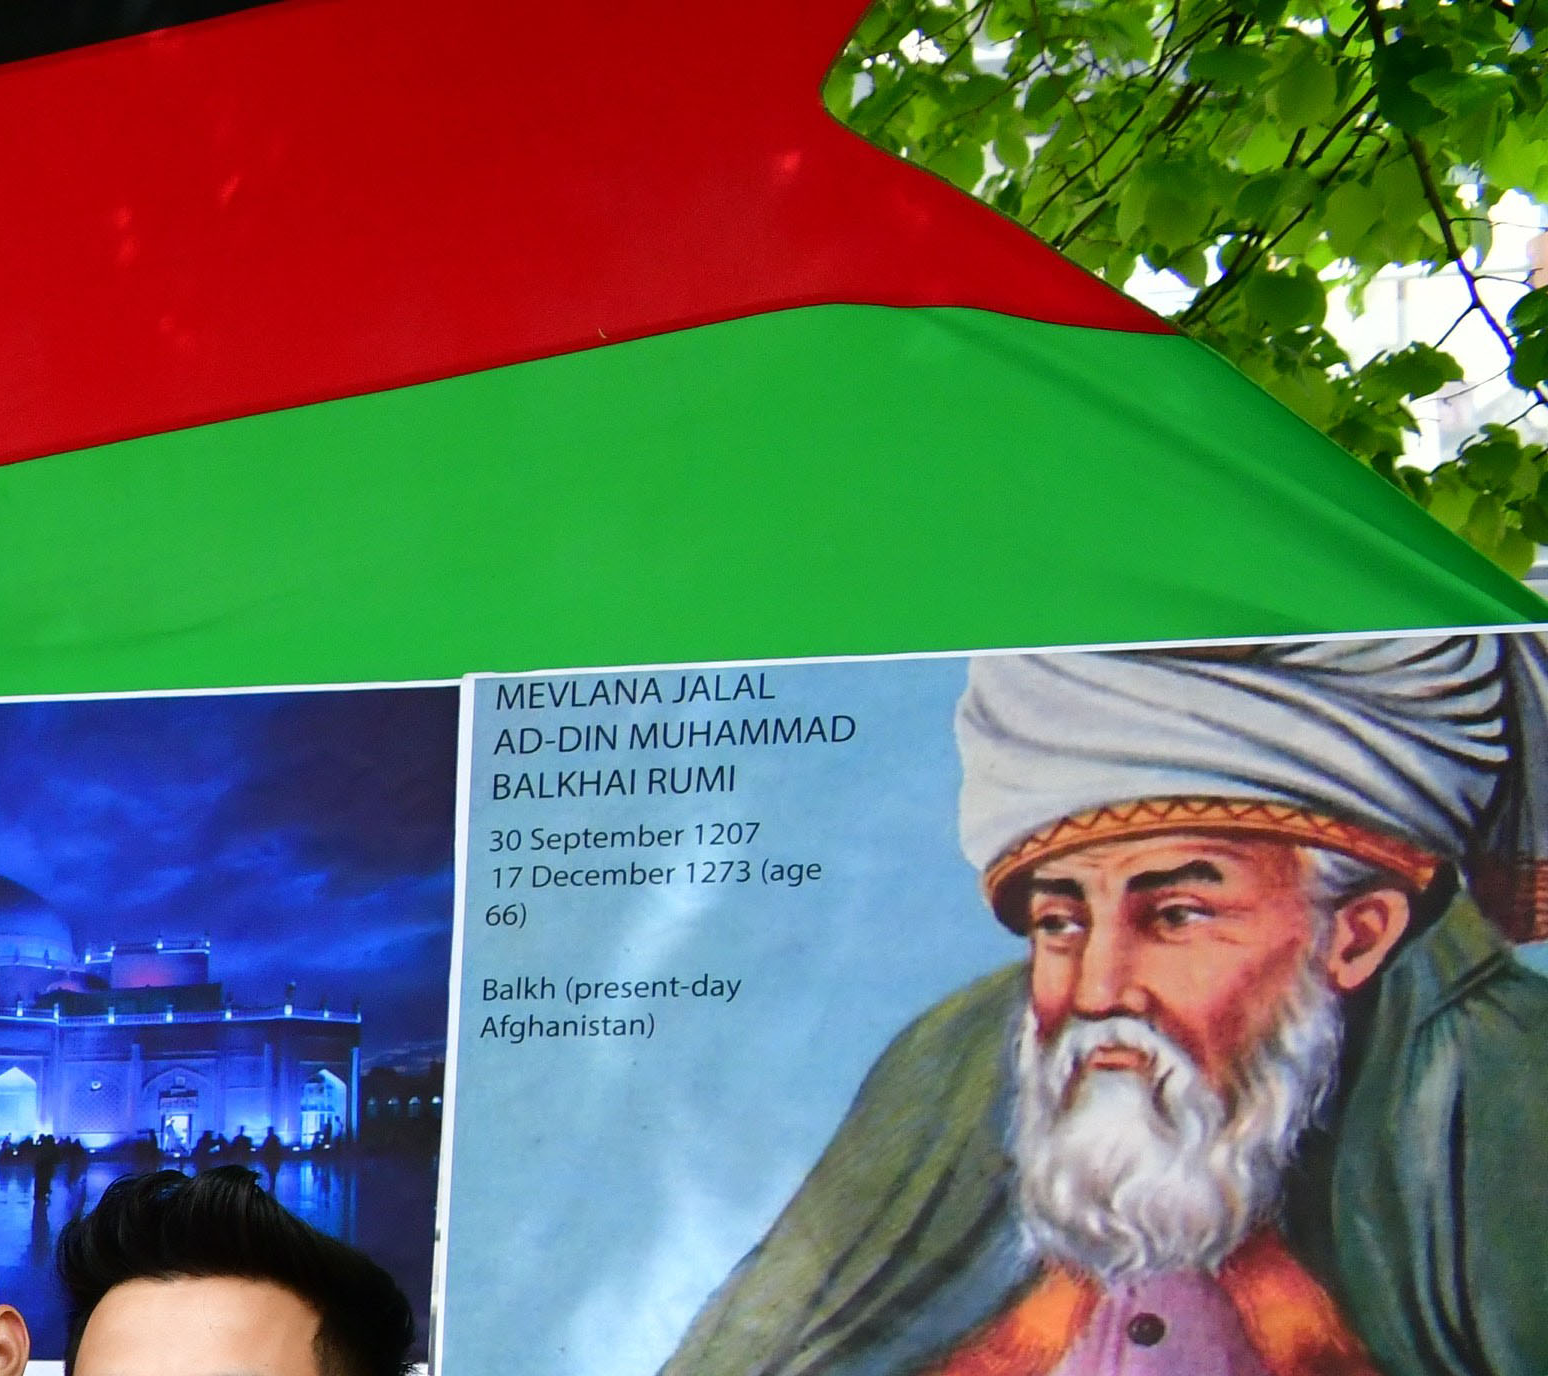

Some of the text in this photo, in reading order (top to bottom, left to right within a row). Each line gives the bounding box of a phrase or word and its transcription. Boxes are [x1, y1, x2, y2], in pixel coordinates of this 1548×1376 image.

[497, 673, 775, 710] MEVLANA JALAL
[494, 716, 855, 755] AD-DIN MUHAMMAD
[493, 765, 734, 800] BALKHAI RUMI
[490, 822, 760, 855] 30 September 1207
[494, 859, 821, 888] 17 December 1273 (age
[486, 903, 526, 928] 66)
[483, 974, 741, 1005] Balkh (present-day
[480, 1013, 654, 1043] Afghanistan)
